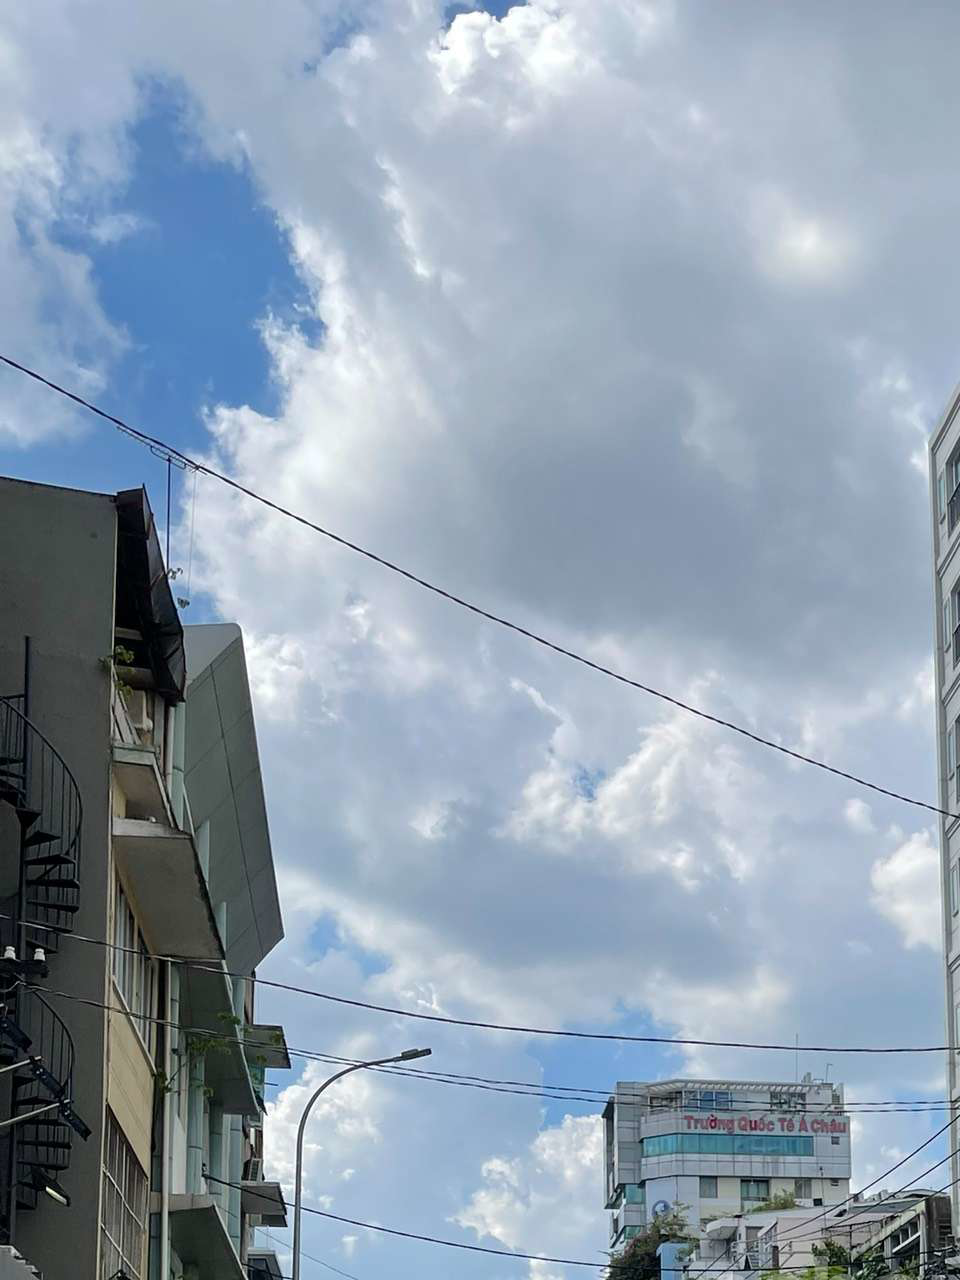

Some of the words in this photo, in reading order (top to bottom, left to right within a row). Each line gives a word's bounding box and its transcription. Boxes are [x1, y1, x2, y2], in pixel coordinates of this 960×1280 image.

[684, 1114, 735, 1134] Trường
[737, 1113, 775, 1132] Quốc
[778, 1115, 795, 1132] Tế
[798, 1114, 809, 1132] Á
[810, 1116, 847, 1133] Châu
